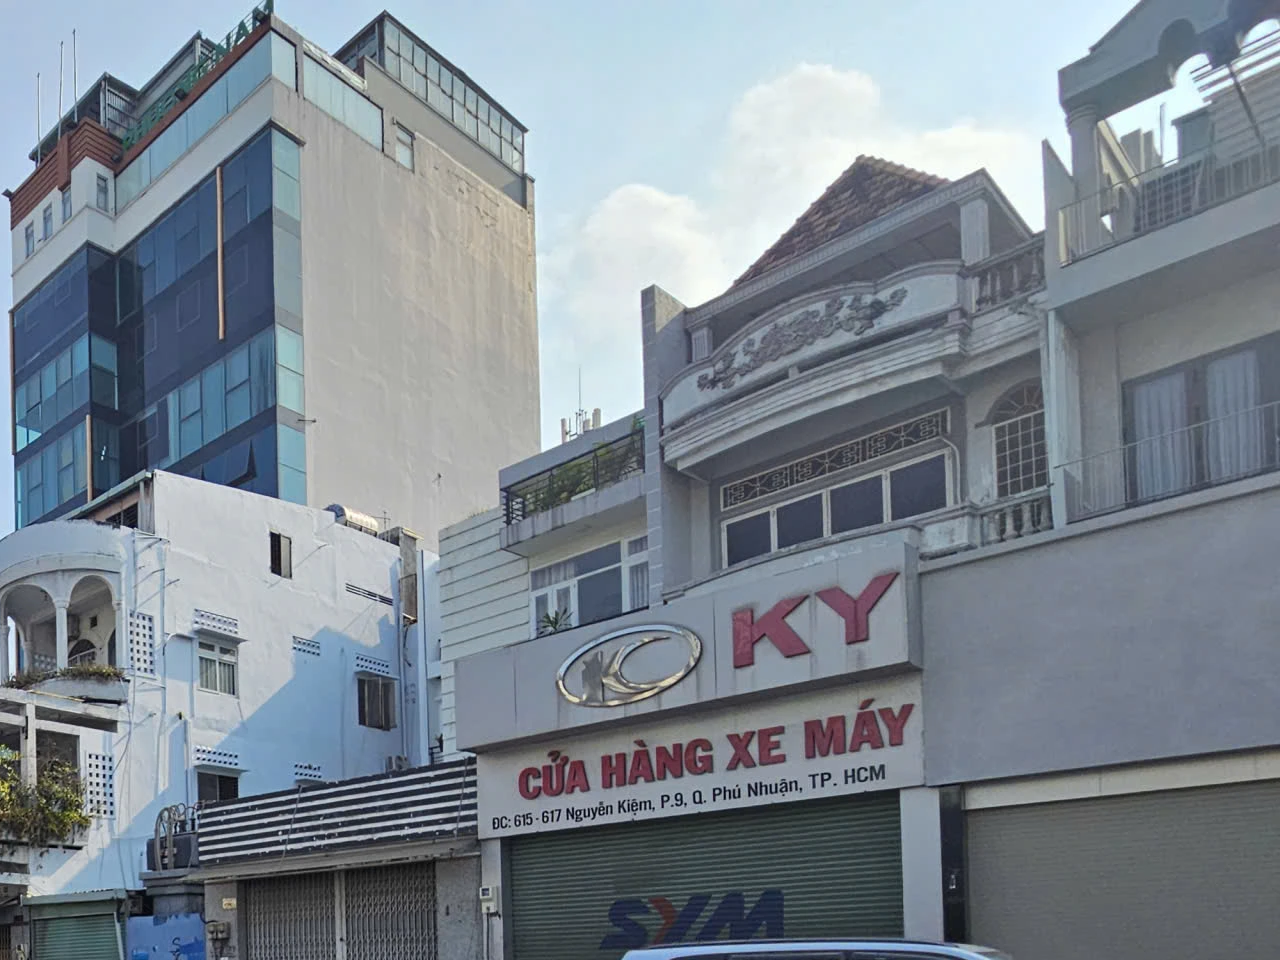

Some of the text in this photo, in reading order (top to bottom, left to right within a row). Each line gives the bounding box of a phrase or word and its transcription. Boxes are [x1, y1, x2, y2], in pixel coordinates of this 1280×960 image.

[732, 571, 901, 669] KY
[518, 698, 915, 800] CỬA HÀNG XE MÁY
[492, 816, 512, 830] ĐC:
[566, 802, 613, 822] Nguyễn
[618, 798, 656, 816] Kiệm,
[660, 792, 688, 809] P.9,
[692, 789, 707, 804] Q.
[712, 783, 741, 803] Phú
[747, 778, 803, 798] Nhuận,
[808, 771, 837, 790] TP.
[843, 763, 886, 785] HCM
[599, 888, 785, 950] SYM
